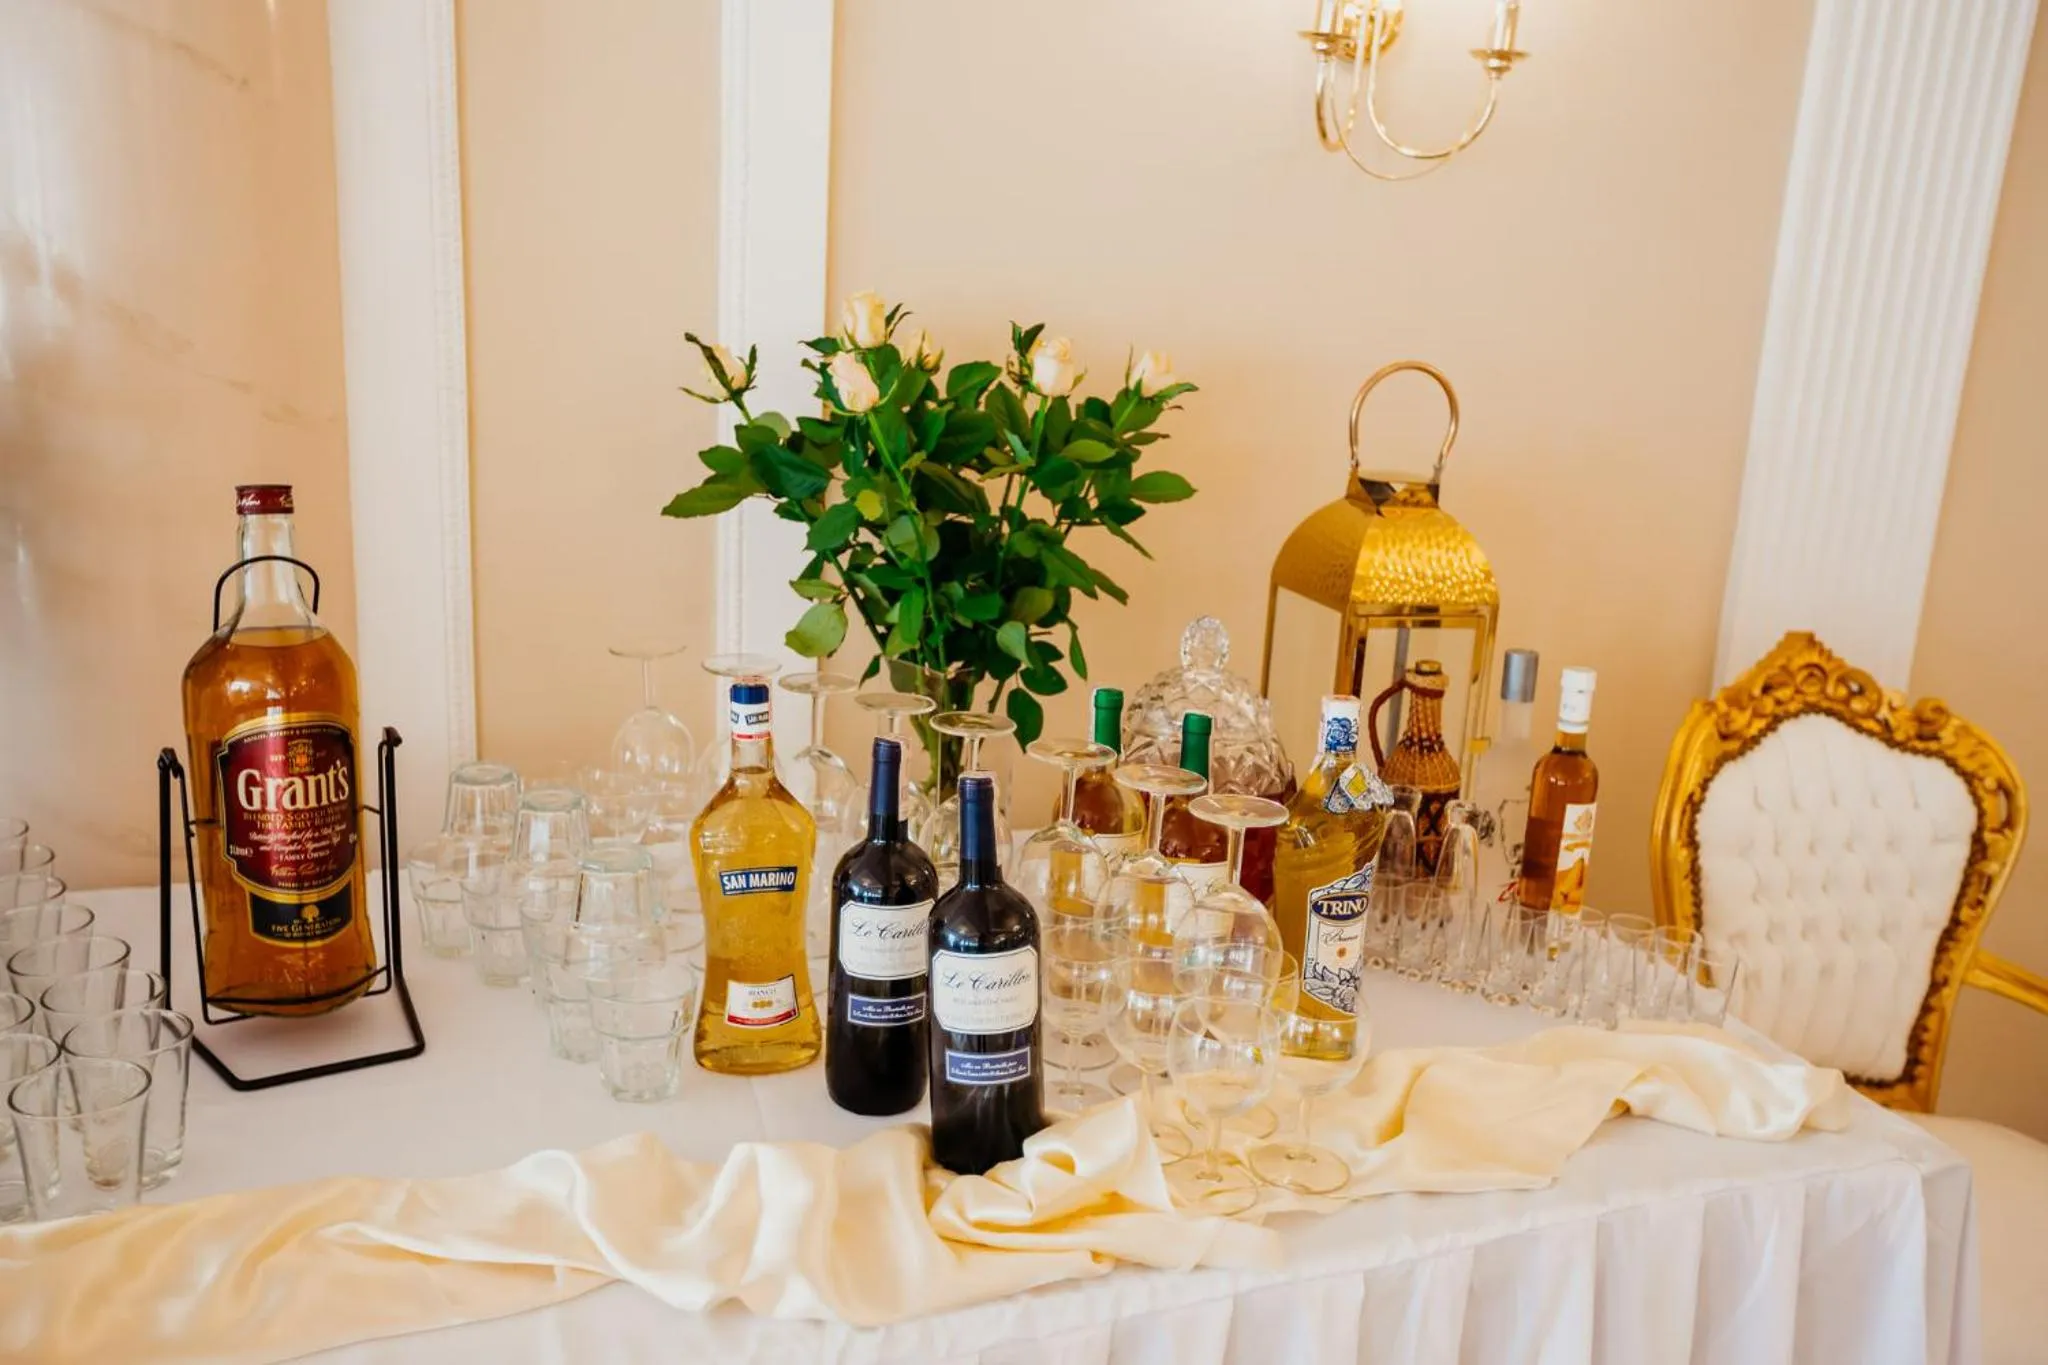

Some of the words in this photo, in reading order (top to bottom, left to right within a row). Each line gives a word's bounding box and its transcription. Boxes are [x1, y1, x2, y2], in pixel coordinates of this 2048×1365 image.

[237, 760, 350, 812] Grant's
[722, 874, 747, 890] SAN
[749, 871, 795, 889] MARINO
[1318, 898, 1367, 916] TRINO
[852, 920, 872, 937] Le
[941, 968, 963, 989] Le
